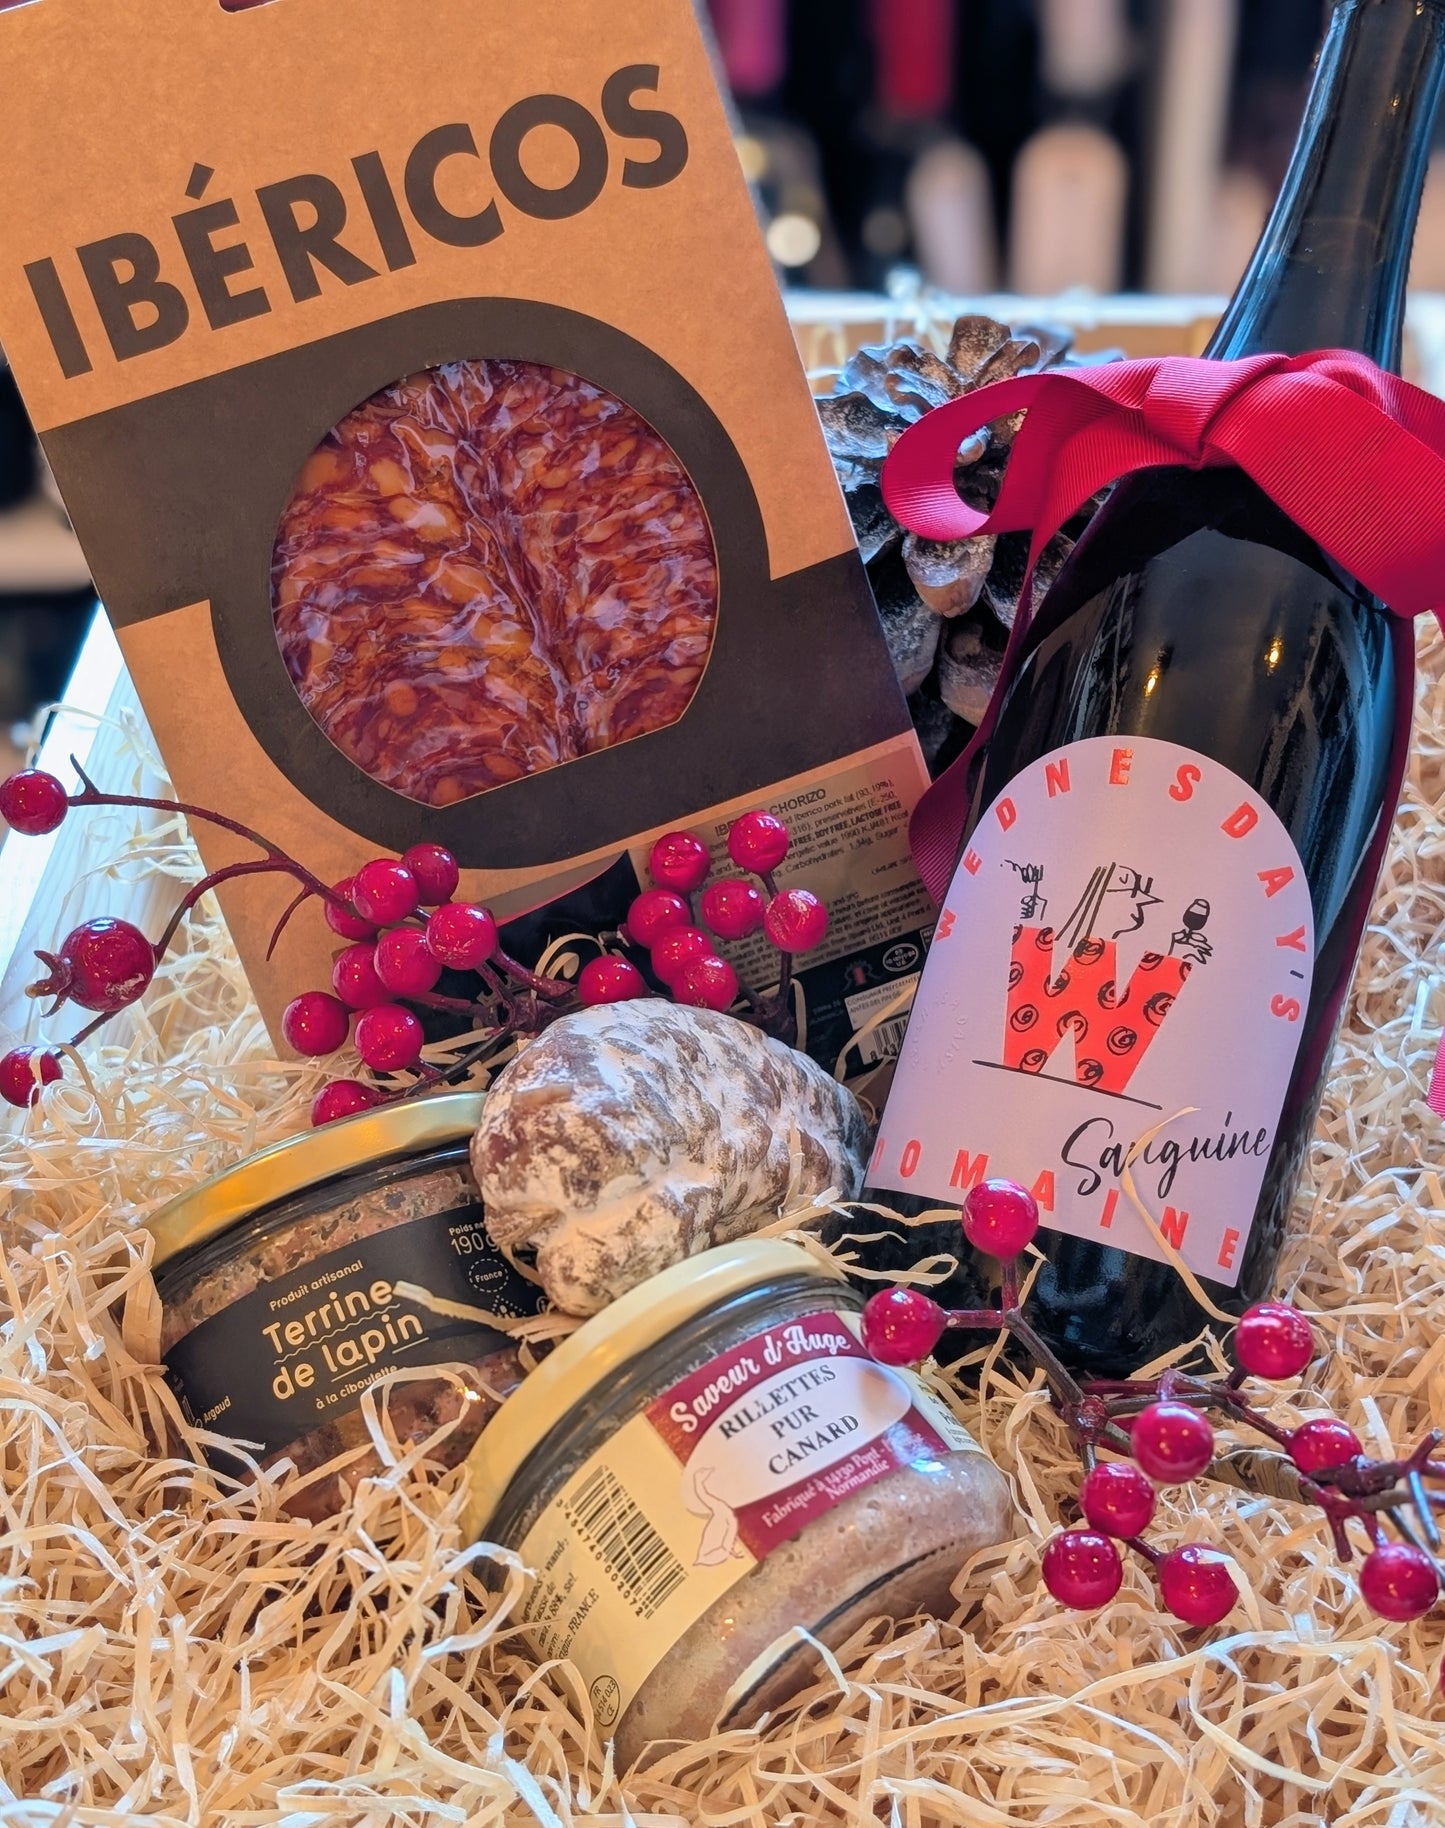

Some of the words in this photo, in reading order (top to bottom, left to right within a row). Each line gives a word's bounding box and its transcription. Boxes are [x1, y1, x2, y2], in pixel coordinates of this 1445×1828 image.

[24, 64, 690, 380] IBÉRICOS
[769, 788, 826, 816] CHORIZO
[851, 808, 881, 828] LACTOSE
[882, 800, 902, 814] FREE
[935, 748, 1307, 1022] WEDNESDAY'S
[448, 1223, 473, 1236] Poids
[269, 1285, 309, 1311] Produit
[311, 1259, 364, 1290] artisanal
[475, 1270, 503, 1283] France
[262, 1280, 393, 1354] Terrine
[272, 1363, 316, 1400] de
[321, 1314, 423, 1373] lapin
[670, 1357, 761, 1433] Saveur
[763, 1325, 851, 1365] d'Auge
[203, 1395, 231, 1424] Argaud
[316, 1398, 325, 1409] à
[325, 1393, 338, 1405] la
[339, 1365, 398, 1398] ciboulette
[718, 1364, 837, 1440] RILLETTES
[768, 1414, 859, 1475] CANARD
[769, 1404, 820, 1439] PUR
[761, 1484, 817, 1528] Fabriqué
[812, 1476, 826, 1492] à
[825, 1459, 890, 1500] Normandie
[557, 1633, 574, 1660] rigine
[568, 1588, 600, 1632] FRANCE
[592, 1685, 602, 1698] FR
